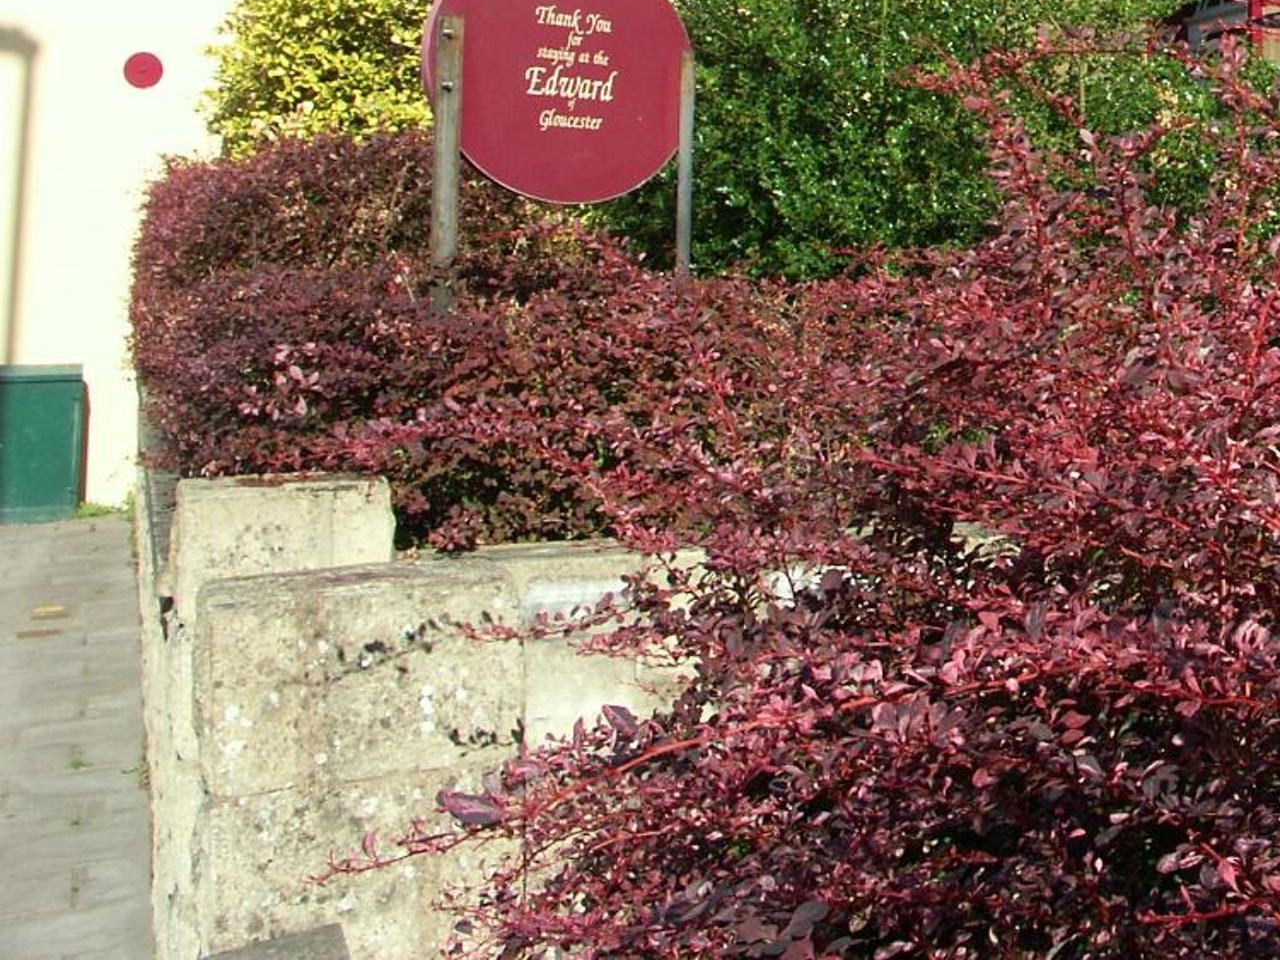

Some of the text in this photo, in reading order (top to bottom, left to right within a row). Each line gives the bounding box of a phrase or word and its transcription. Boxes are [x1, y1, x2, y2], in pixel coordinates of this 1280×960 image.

[535, 4, 612, 34] Thank You
[566, 30, 582, 50] for
[536, 46, 610, 67] staying at the
[525, 65, 618, 101] Edward
[567, 98, 577, 111] of
[538, 109, 603, 132] Gloucester
